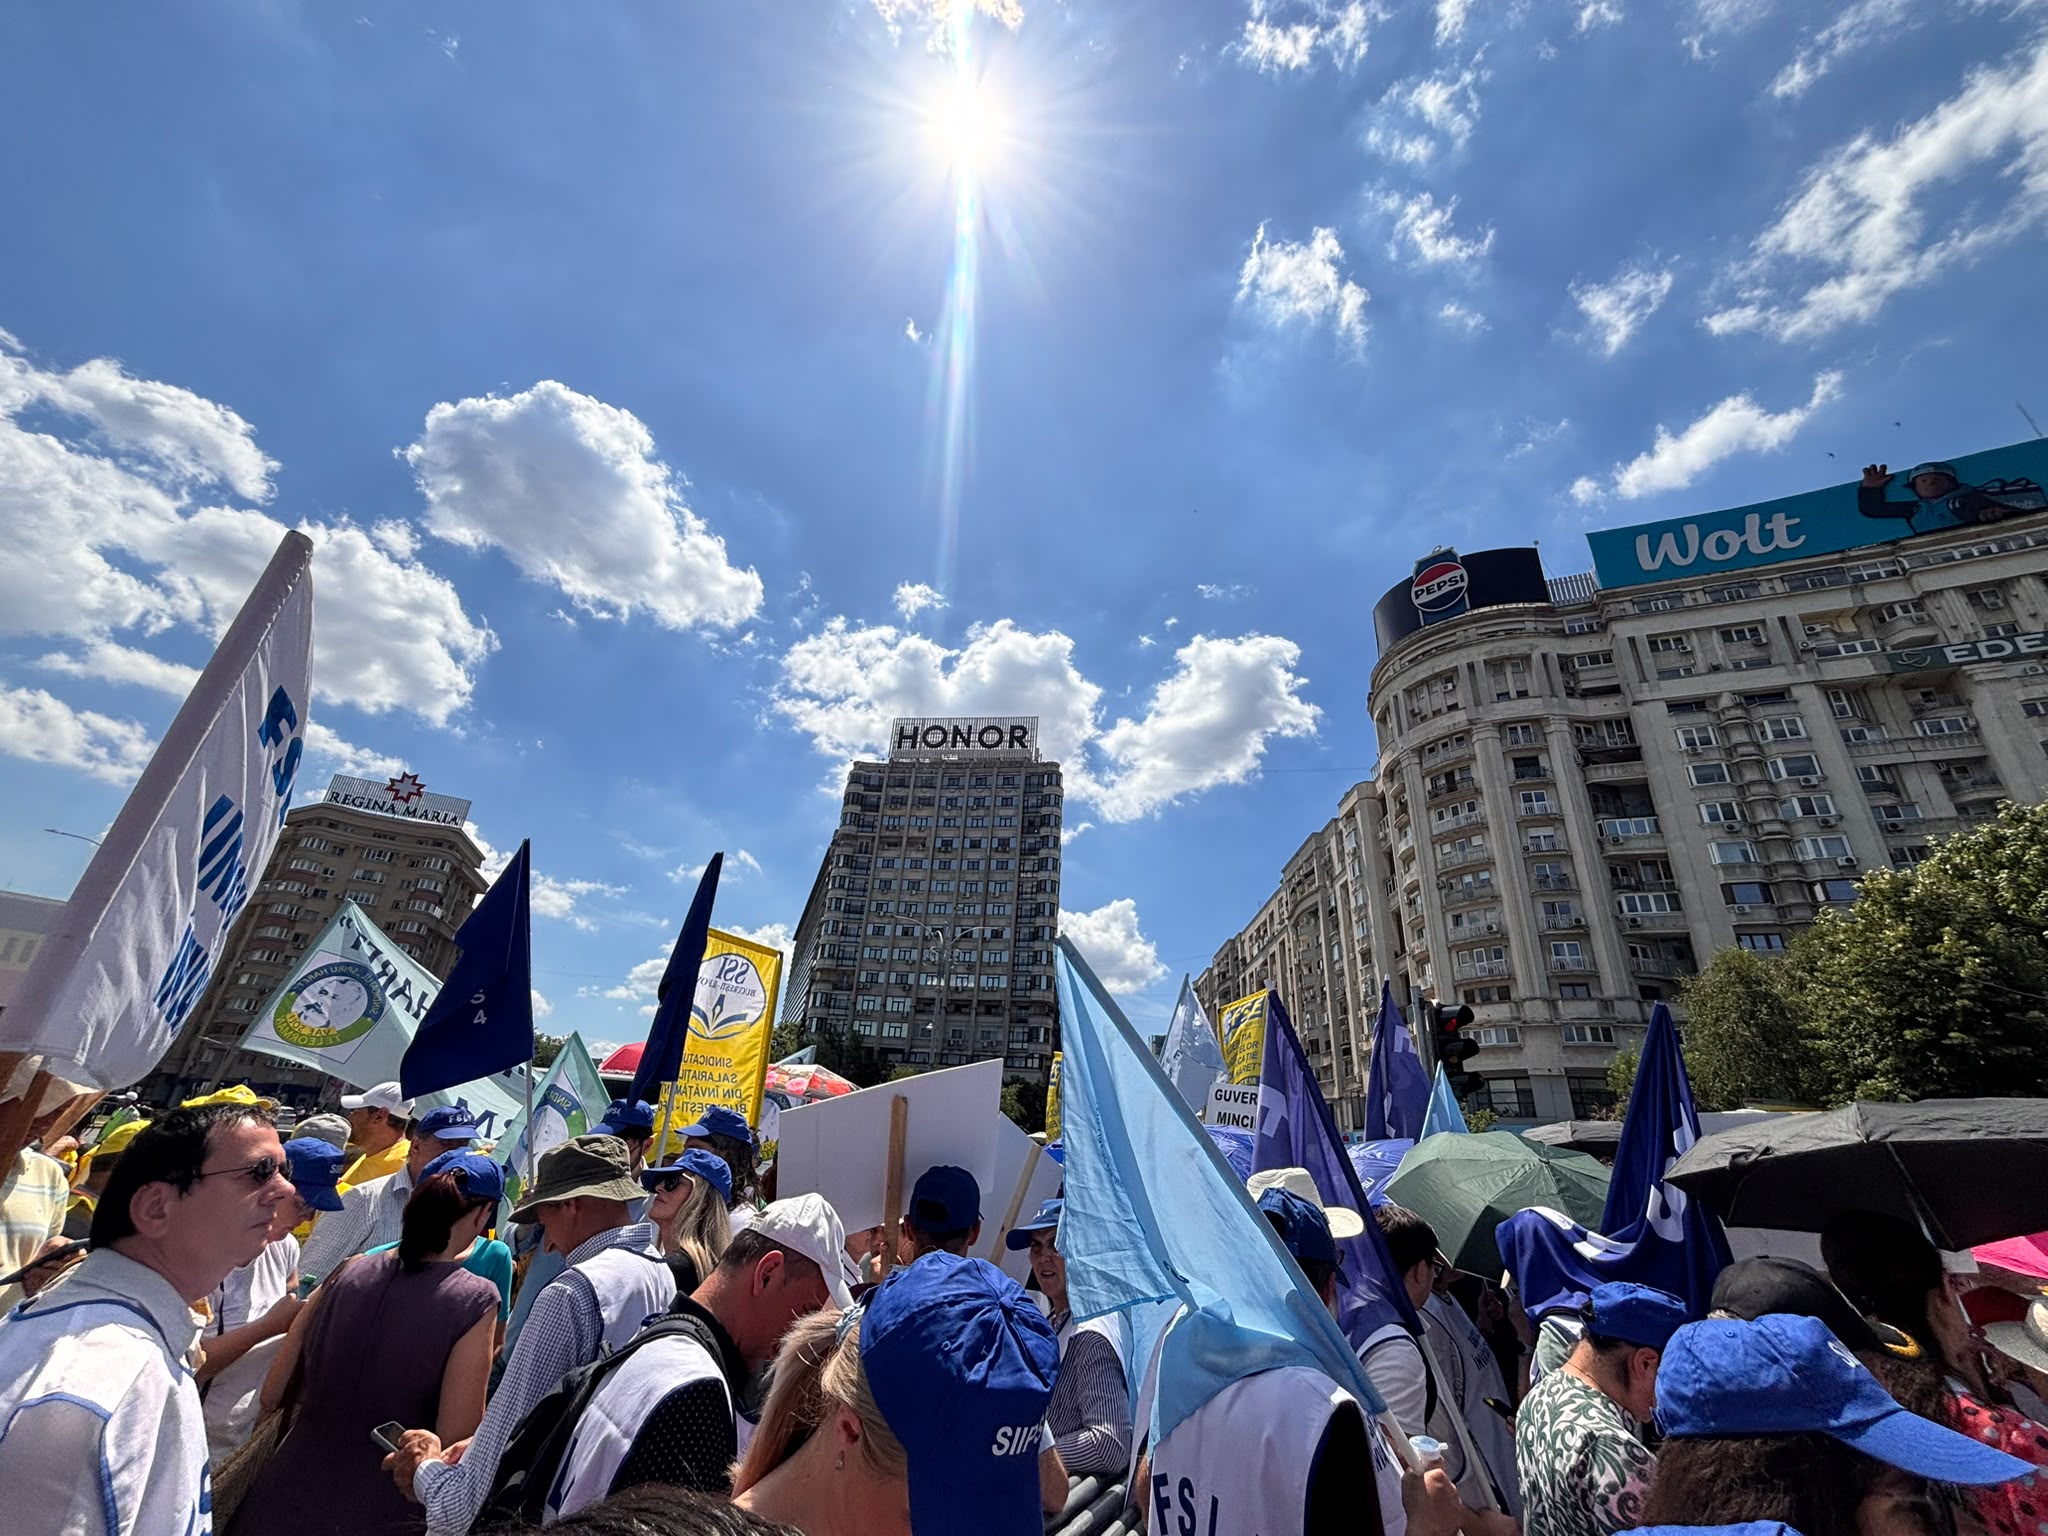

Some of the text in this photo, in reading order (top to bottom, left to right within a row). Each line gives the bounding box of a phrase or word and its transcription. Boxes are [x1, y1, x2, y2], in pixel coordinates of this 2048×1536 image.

[1635, 512, 1806, 571] Wolt
[1414, 572, 1465, 600] PEPSI
[897, 724, 1028, 749] HONOR
[329, 791, 459, 826] REGINA MARIA
[1216, 1111, 1256, 1129] MINCI
